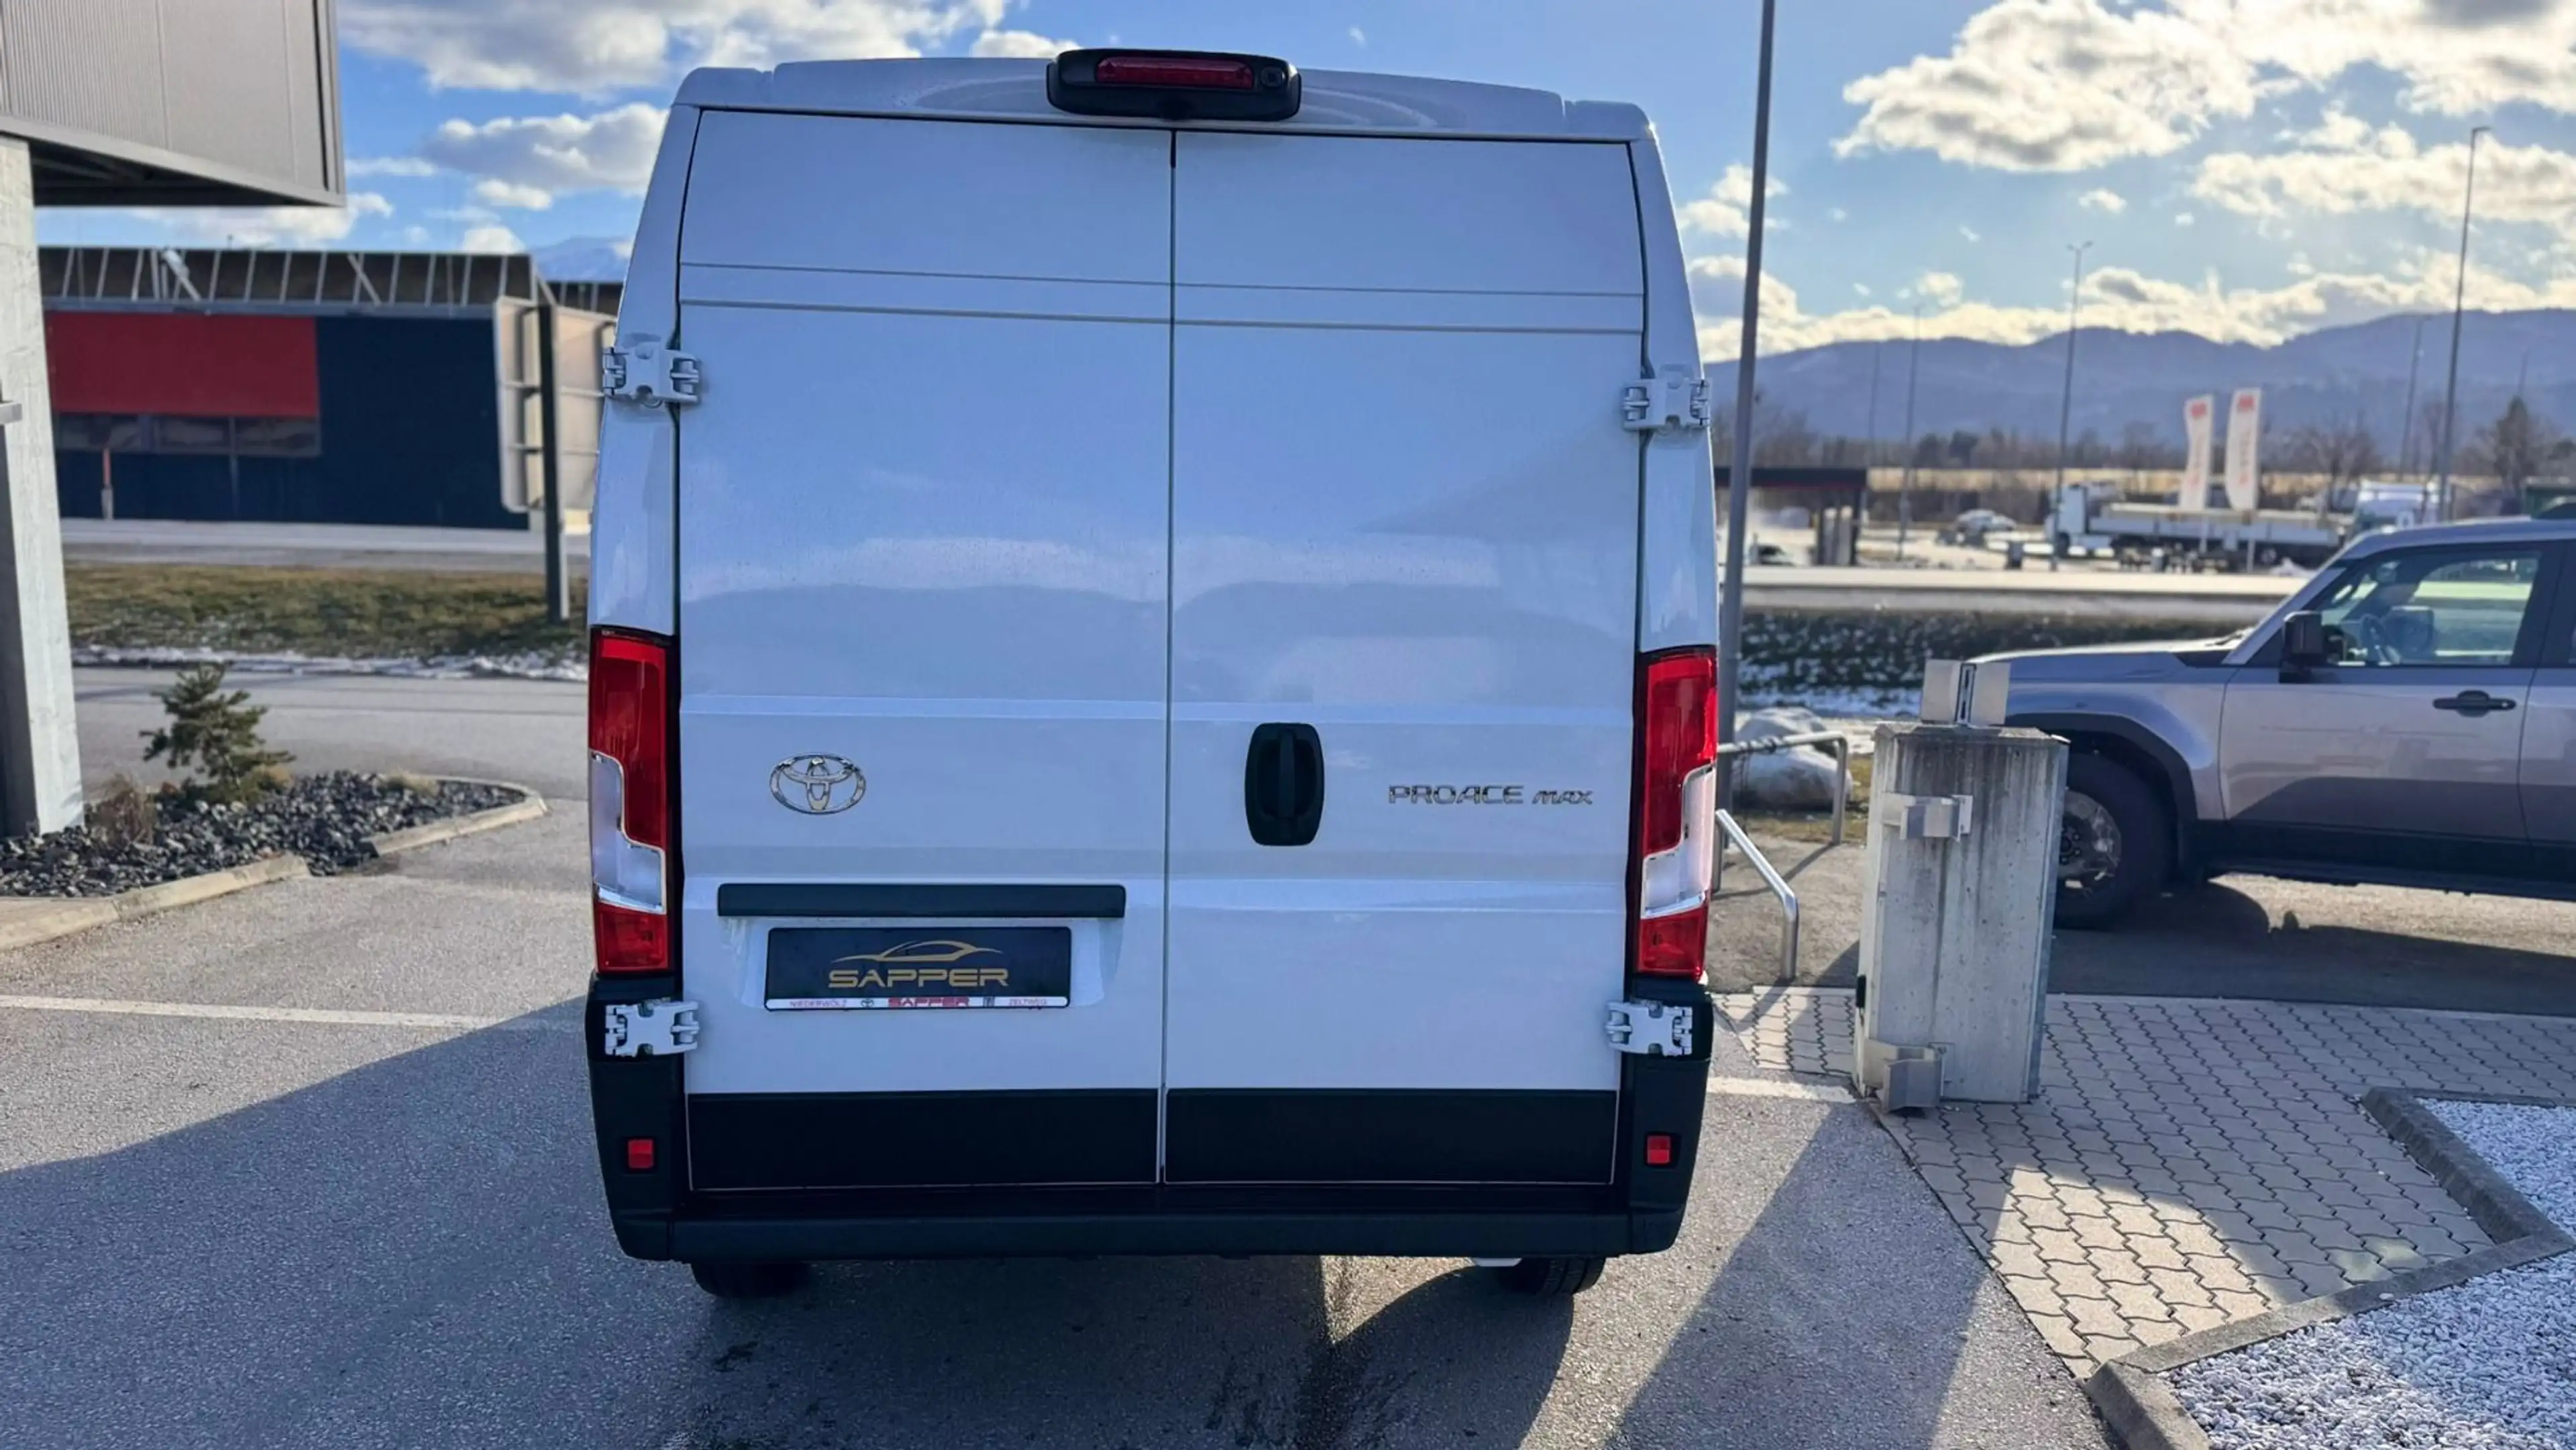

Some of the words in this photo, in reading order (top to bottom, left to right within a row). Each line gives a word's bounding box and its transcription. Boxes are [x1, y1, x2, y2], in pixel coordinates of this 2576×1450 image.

[1388, 785, 1524, 805] PROACE
[1532, 790, 1594, 805] MAX
[828, 968, 1009, 988] SAPPER
[888, 997, 969, 1008] SAPPER
